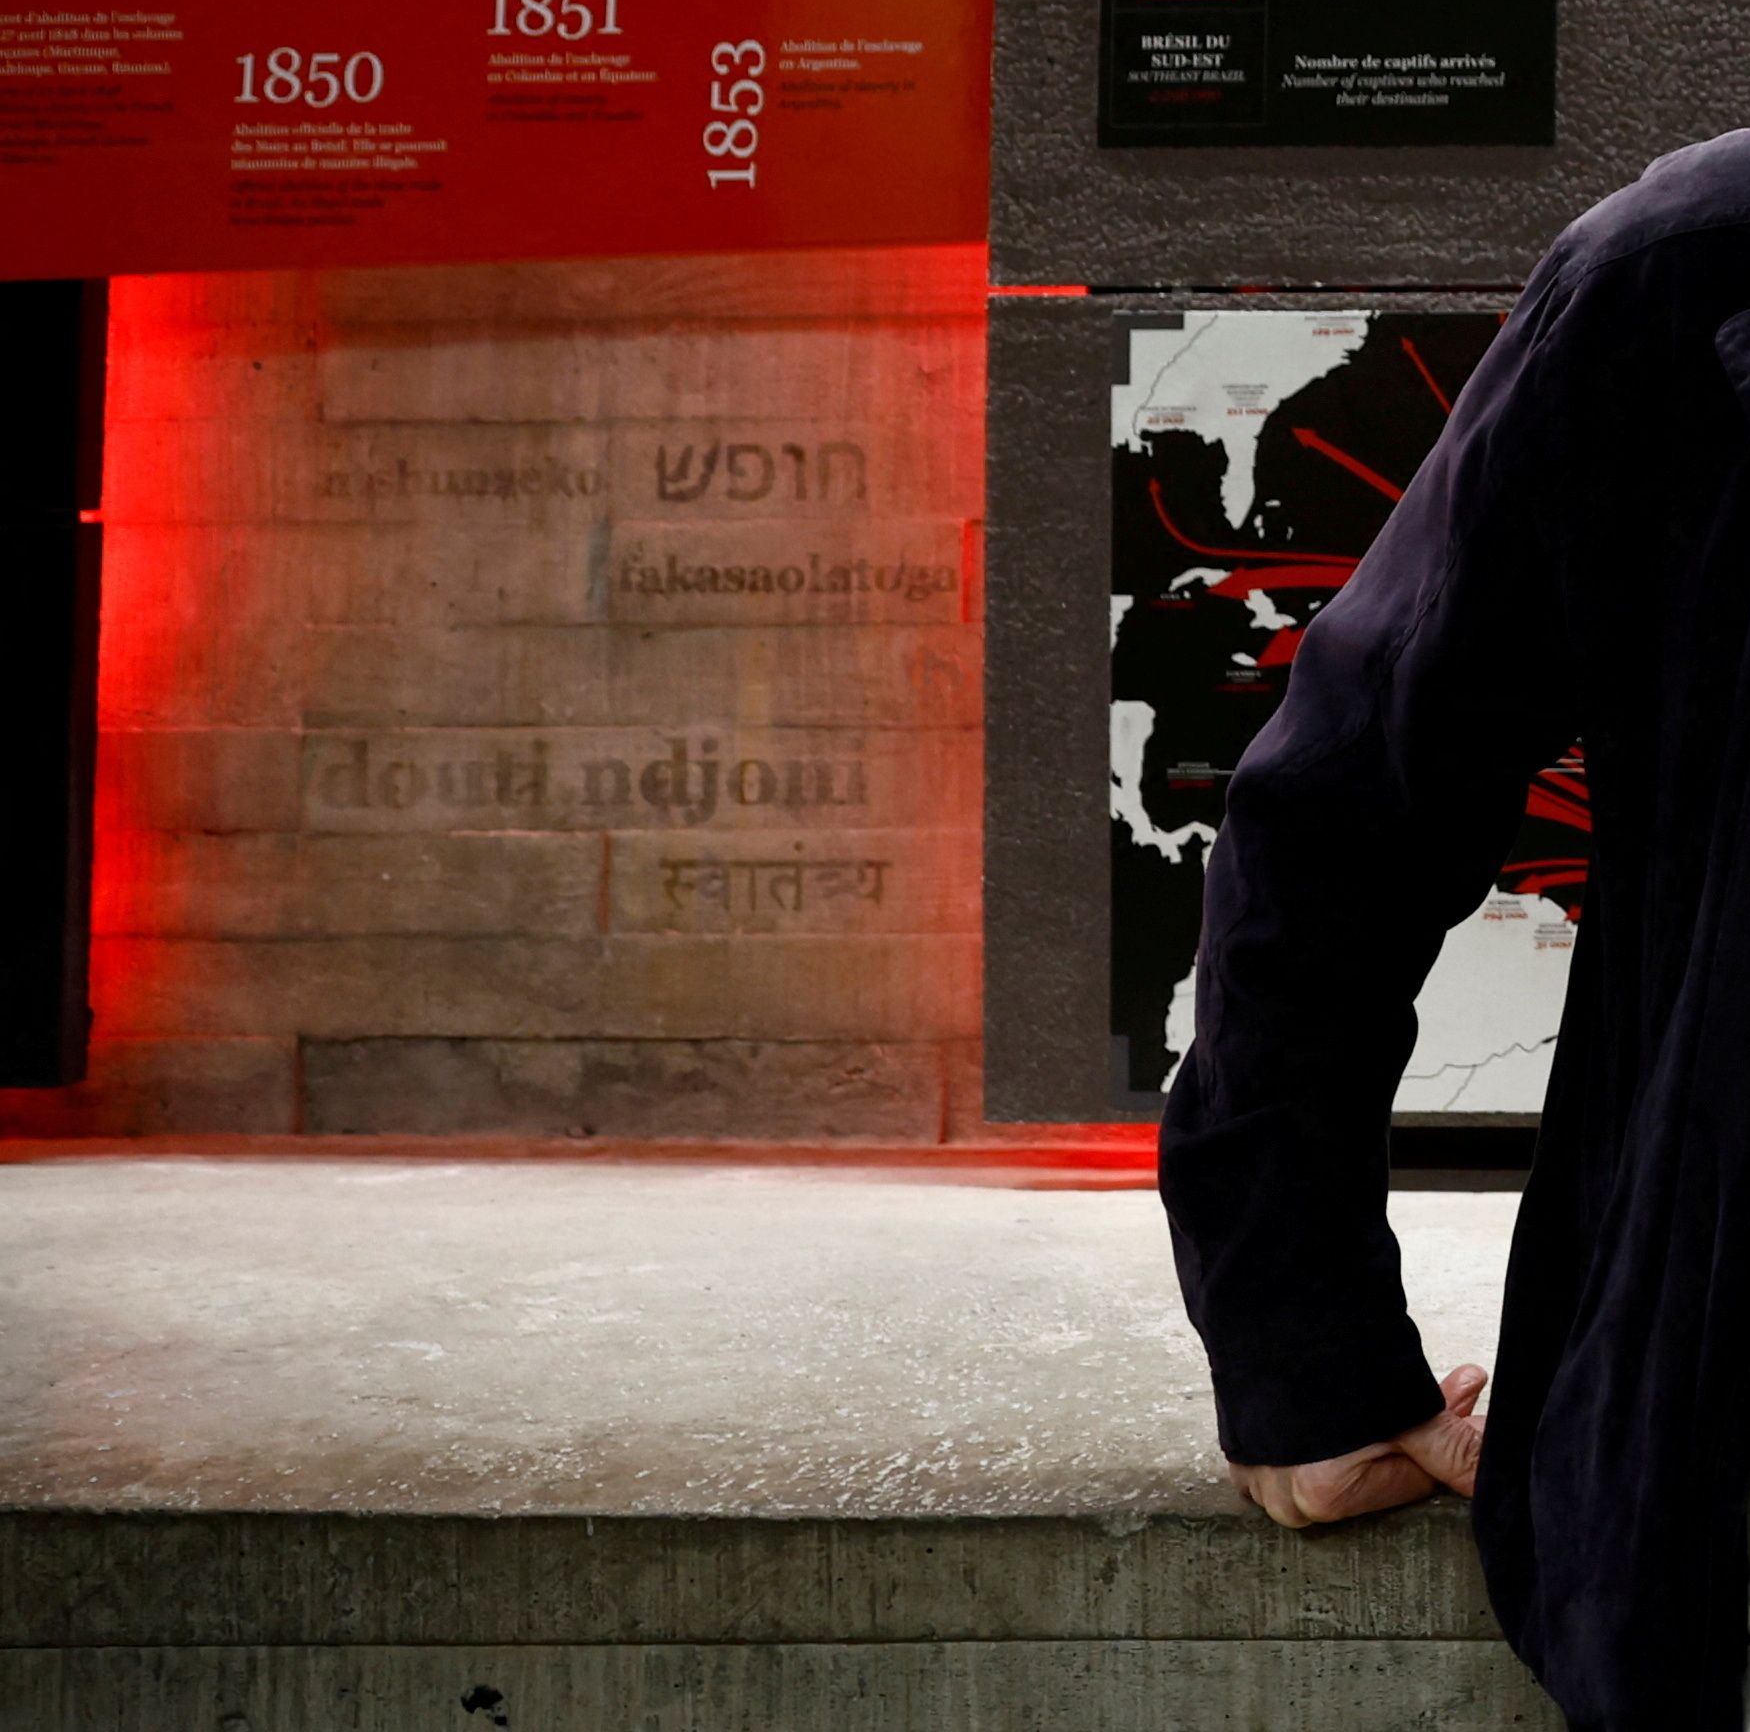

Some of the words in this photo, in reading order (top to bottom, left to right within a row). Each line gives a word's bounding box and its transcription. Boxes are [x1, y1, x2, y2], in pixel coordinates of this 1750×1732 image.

[839, 40, 856, 53] de
[1141, 32, 1203, 50] BRÉSIL
[1206, 34, 1231, 50] DU
[1151, 52, 1224, 68] SUD-EST
[1294, 54, 1357, 70] Nombre
[1361, 54, 1380, 69] de
[1383, 53, 1436, 71] captifs
[1438, 53, 1496, 69] arrivés
[233, 47, 384, 108] 1850
[1281, 72, 1338, 88] Number
[1340, 72, 1355, 90] of
[1357, 72, 1415, 90] captives
[1417, 72, 1447, 88] who
[1449, 71, 1506, 88] reached
[1336, 90, 1369, 106] their
[1371, 90, 1449, 106] destination
[703, 39, 767, 190] 1853
